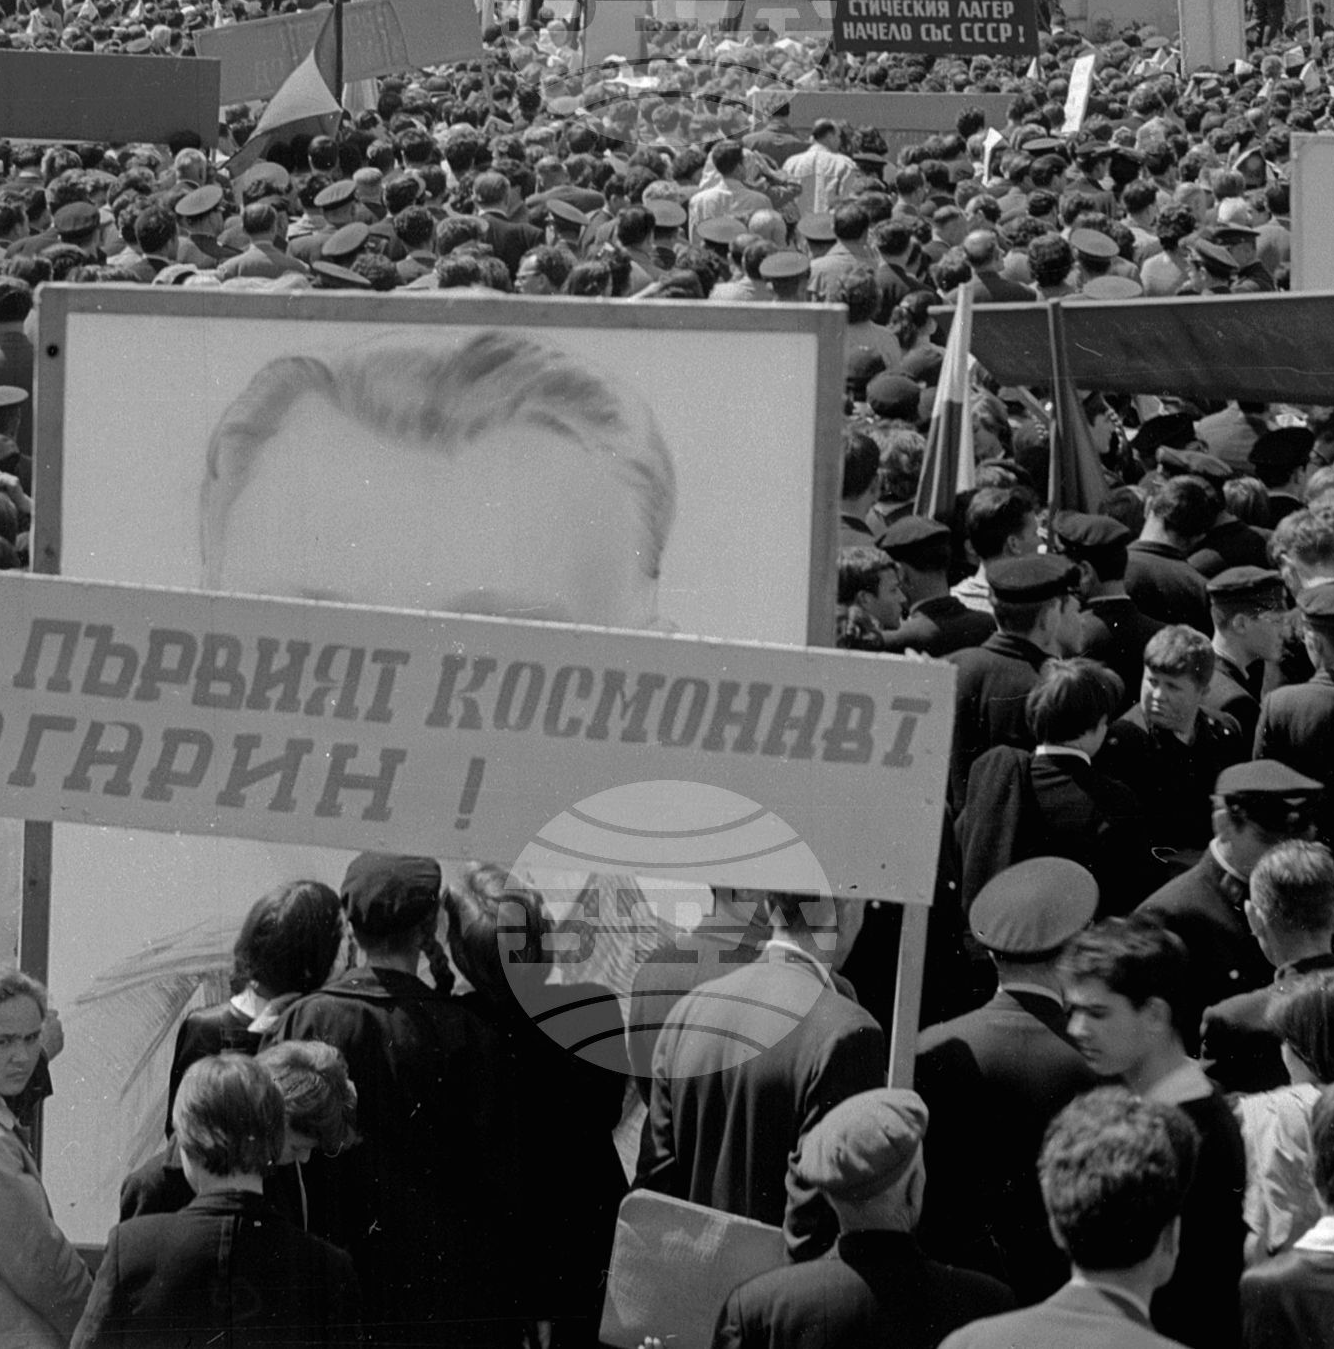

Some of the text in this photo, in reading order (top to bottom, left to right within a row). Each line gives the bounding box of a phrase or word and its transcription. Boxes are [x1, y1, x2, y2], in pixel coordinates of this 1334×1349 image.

[848, 0, 1015, 19] СТИЧЕСКИЯ ЛАГЕР
[842, 21, 913, 41] НАЧЕЛО
[959, 22, 1013, 43] СССР
[12, 617, 411, 724] ПЪРВИЯТ
[424, 653, 932, 769] КОСМОНАВТ
